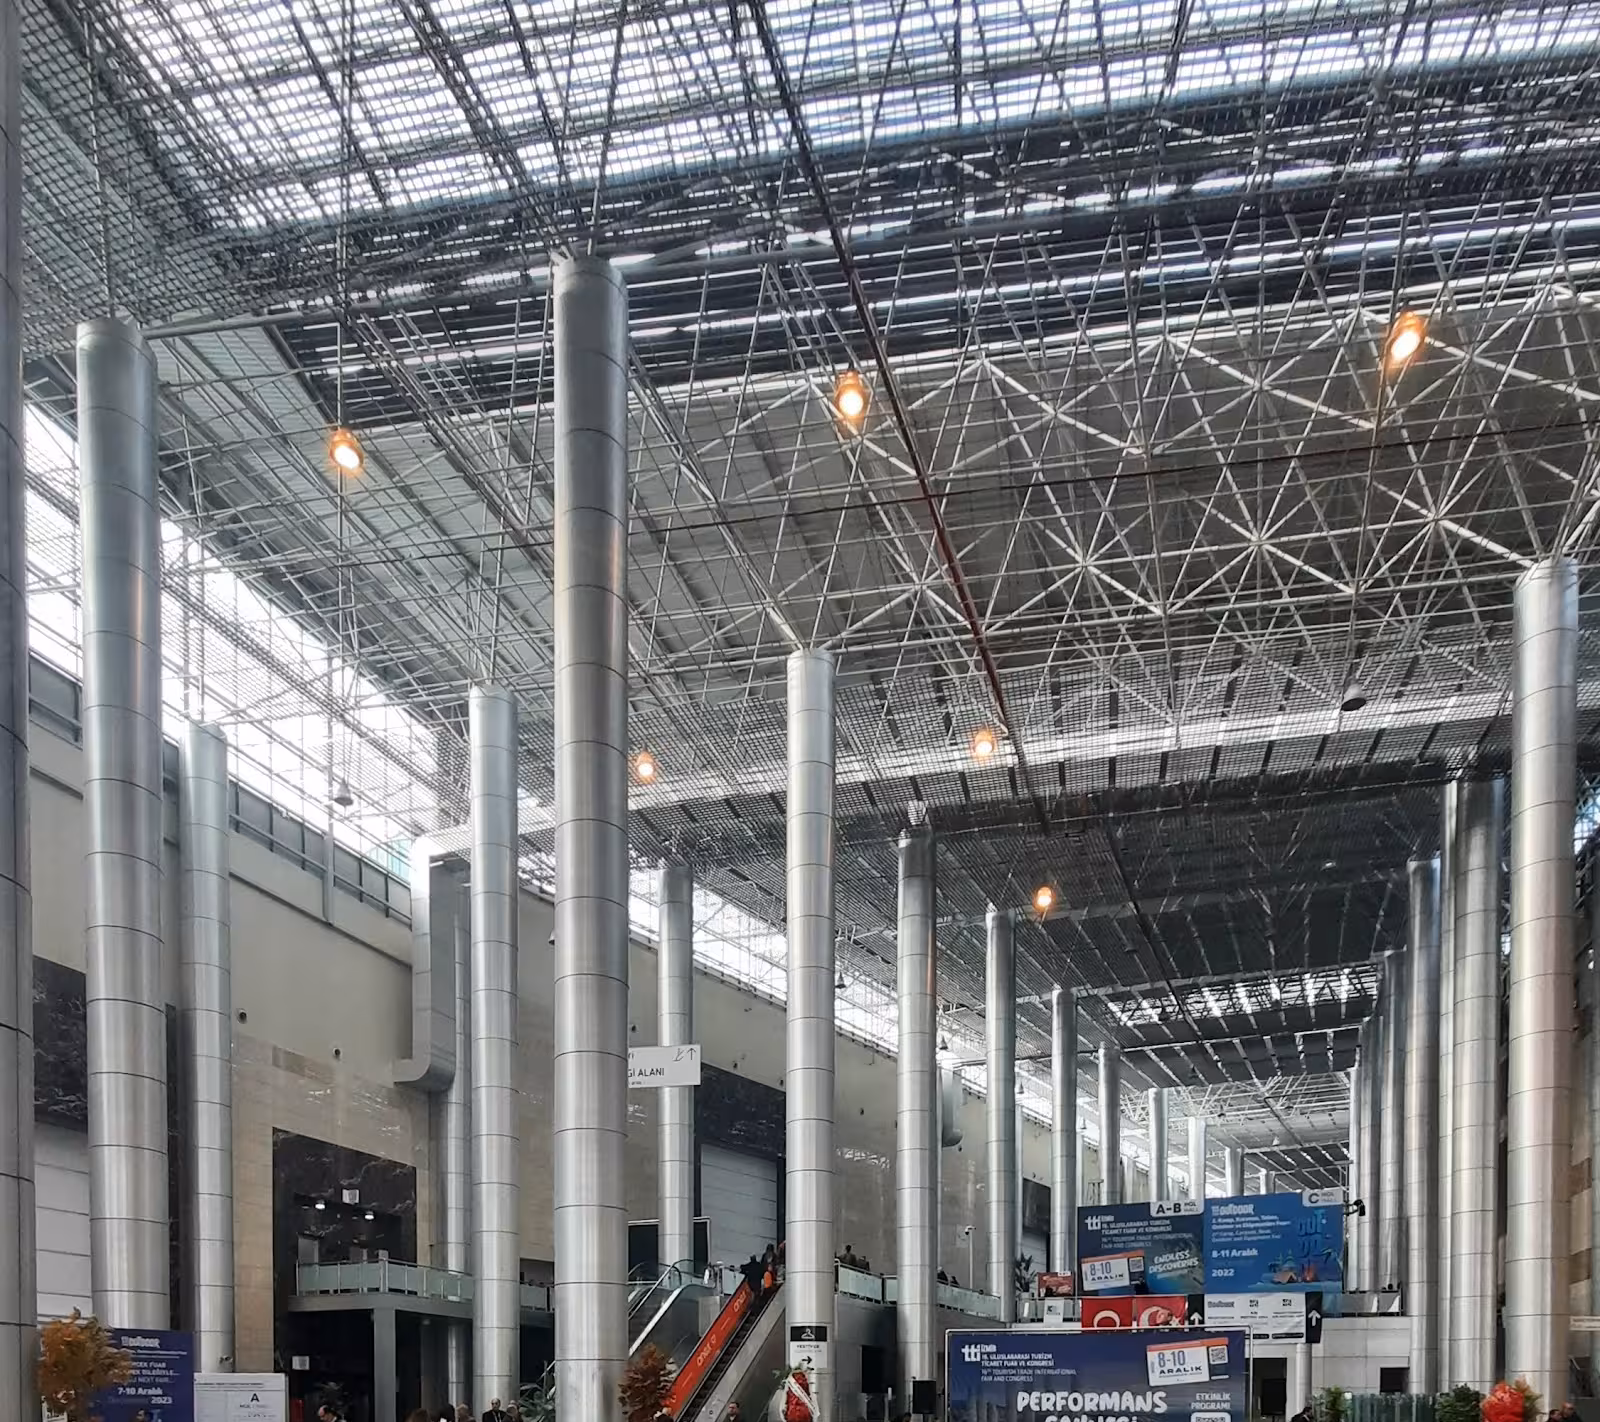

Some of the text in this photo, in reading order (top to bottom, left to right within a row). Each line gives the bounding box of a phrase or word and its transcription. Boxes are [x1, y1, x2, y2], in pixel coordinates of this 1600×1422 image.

[637, 1067, 665, 1077] ALANI
[1308, 1192, 1320, 1204] C
[1156, 1202, 1182, 1215] A-B
[1089, 1260, 1112, 1277] 8-10
[1211, 1268, 1235, 1278] 2022
[961, 1343, 981, 1362] tti
[1031, 1352, 1053, 1360] TURİZM
[1026, 1359, 1055, 1367] KONGRESİ
[1157, 1349, 1187, 1369] 8-10
[1158, 1364, 1203, 1375] ARALIK
[117, 1386, 136, 1396] 7-10
[1195, 1391, 1232, 1401] ETKİNLİK
[150, 1396, 173, 1405] 2023
[1016, 1390, 1168, 1414] PERFORMANS
[1190, 1401, 1232, 1410] PROGRAMI
